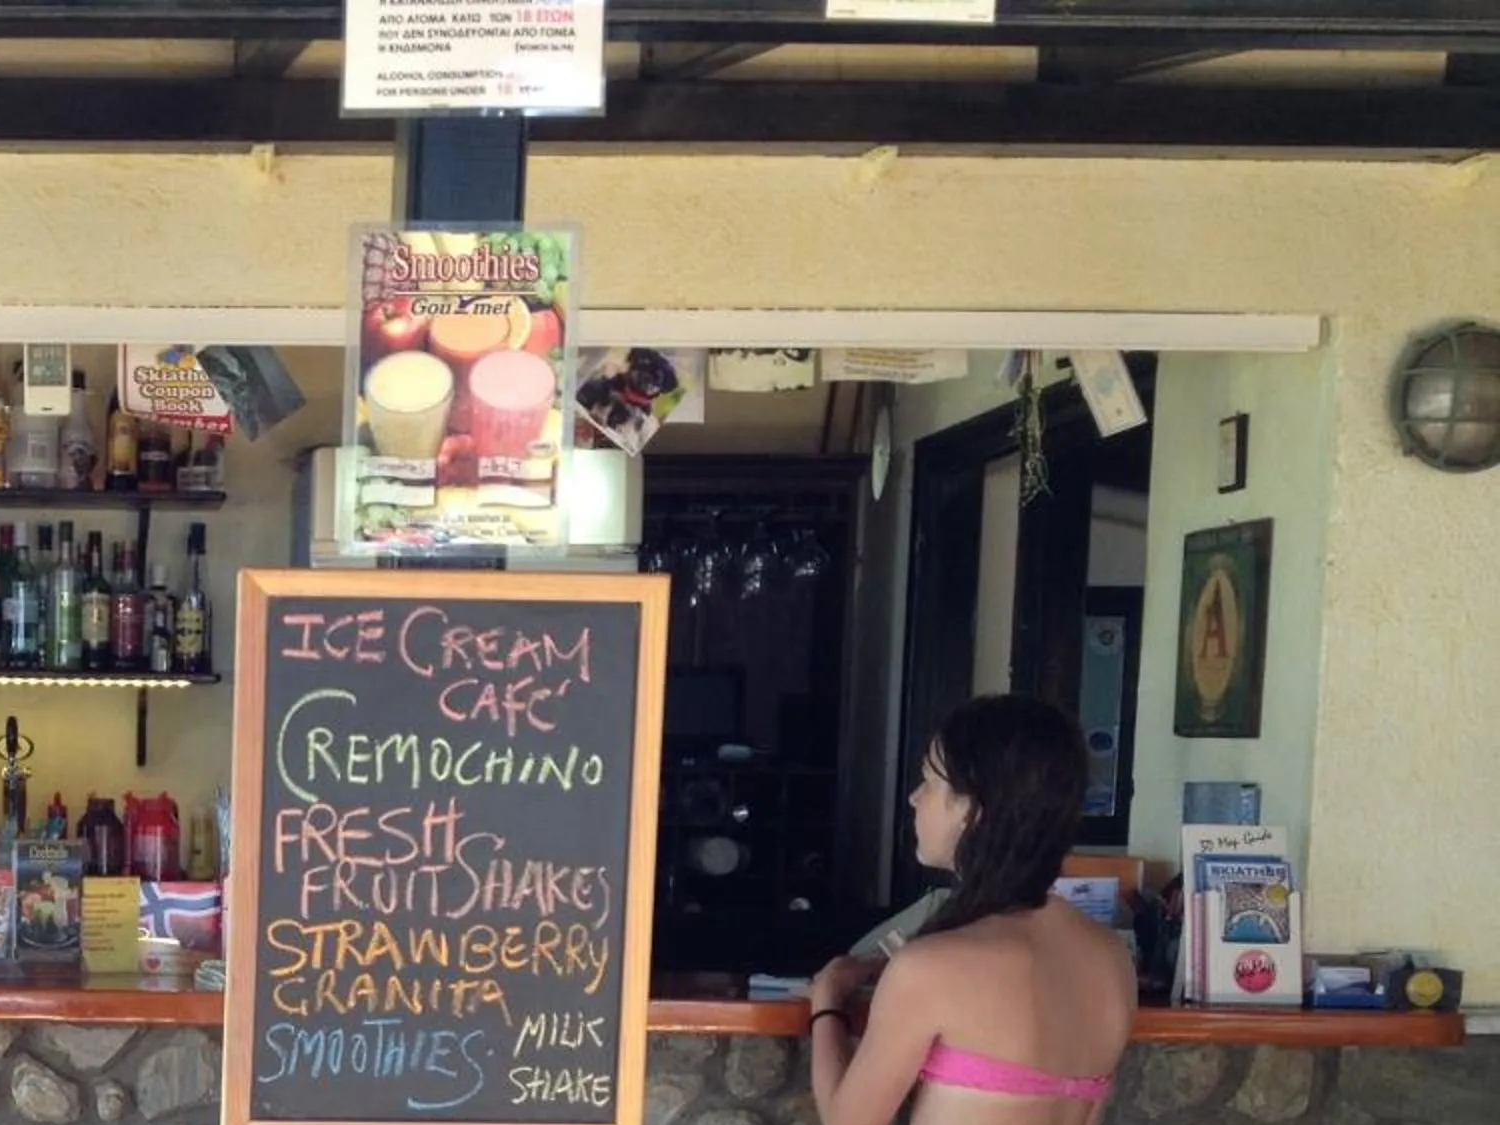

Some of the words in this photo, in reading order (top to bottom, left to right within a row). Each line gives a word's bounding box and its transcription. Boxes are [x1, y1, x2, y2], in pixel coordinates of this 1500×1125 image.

[377, 72, 424, 81] ALCOHOL
[377, 87, 397, 96] FOR
[390, 244, 540, 283] Smoothies
[134, 366, 210, 384] Skiatho
[141, 384, 215, 399] Coupon
[152, 399, 204, 413] Book
[282, 609, 386, 662] ICE
[399, 605, 591, 682] CREAM
[276, 688, 604, 803] CREMOCHINO
[274, 797, 464, 873] FRESH
[301, 857, 451, 919] FRUIT
[446, 832, 611, 930] SHAKES
[273, 970, 513, 1026] GRANITA
[513, 1011, 605, 1057] MILK
[509, 1066, 612, 1107] SHAKE
